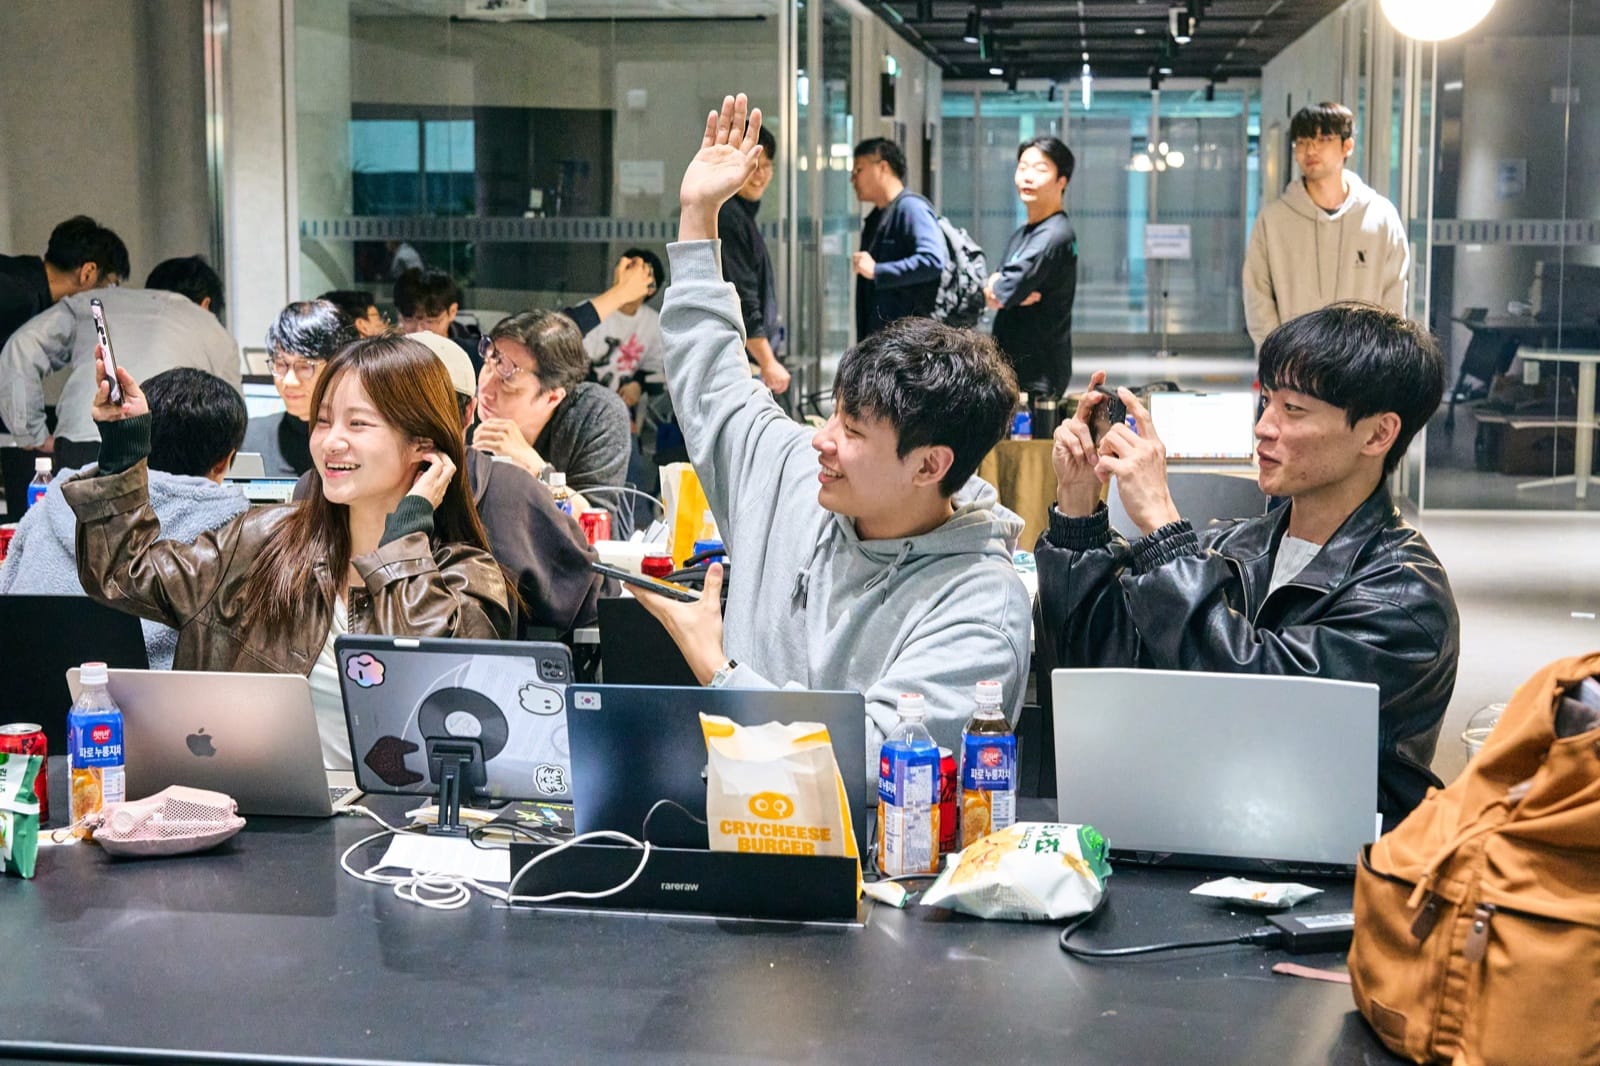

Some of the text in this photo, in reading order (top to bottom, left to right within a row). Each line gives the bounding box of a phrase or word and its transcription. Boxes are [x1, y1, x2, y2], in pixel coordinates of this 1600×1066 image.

[79, 747, 95, 759] 파로
[970, 767, 984, 780] 파로
[719, 819, 832, 842] CRYCHEESE
[737, 836, 816, 856] BURGER
